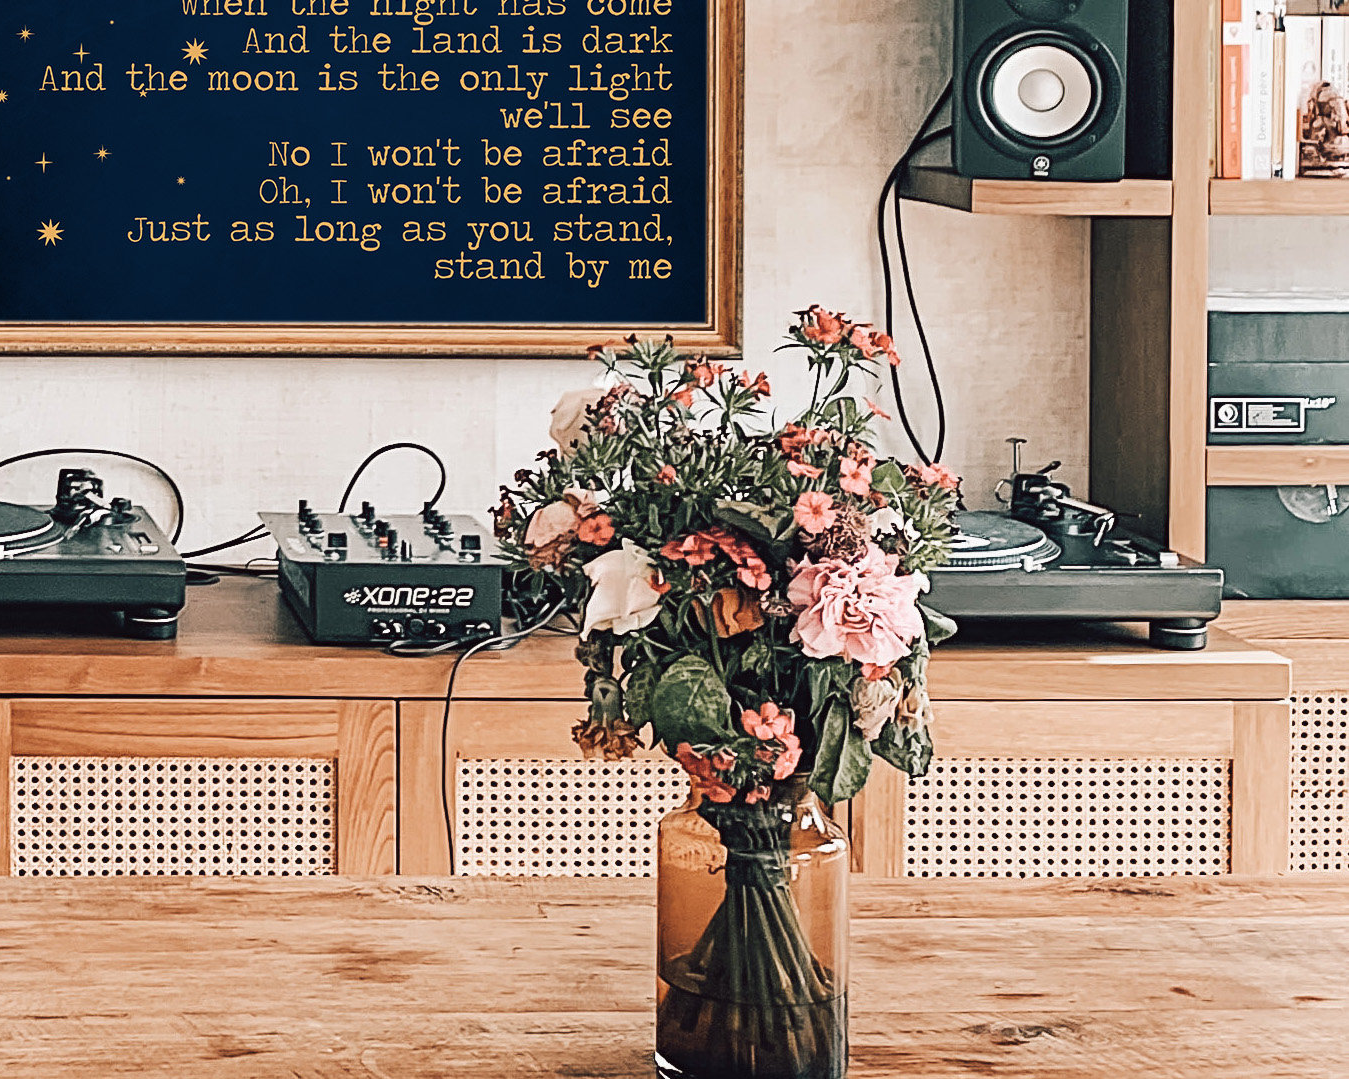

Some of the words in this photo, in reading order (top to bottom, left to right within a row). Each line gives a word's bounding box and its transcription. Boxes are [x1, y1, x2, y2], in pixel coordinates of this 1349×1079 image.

[242, 25, 310, 54] And
[329, 25, 392, 54] the
[411, 23, 503, 54] land
[522, 25, 562, 54] is
[582, 25, 674, 54] dark
[38, 63, 107, 92] And
[125, 63, 189, 92] the
[207, 71, 299, 92] moon
[318, 63, 358, 91] is
[377, 62, 440, 91] the
[459, 63, 549, 100] only
[568, 62, 673, 101] light
[1257, 71, 1268, 96] père
[499, 100, 591, 129] we'll
[610, 107, 673, 129] see
[1257, 100, 1267, 141] Devenir
[268, 141, 311, 167] No
[330, 142, 348, 167] I
[367, 138, 462, 167] won't
[481, 138, 523, 167] be
[542, 138, 673, 167] afraid
[259, 176, 311, 208] Oh,
[330, 179, 348, 204] I
[367, 175, 462, 205] won't
[481, 176, 523, 204] be
[542, 175, 673, 205] afraid
[127, 213, 211, 243] Just
[230, 220, 275, 242] as
[294, 215, 382, 252] long
[402, 221, 447, 242] as
[467, 221, 534, 252] you
[553, 213, 673, 248] stand,
[434, 251, 546, 280] stand
[565, 251, 610, 289] by
[628, 258, 672, 280] me
